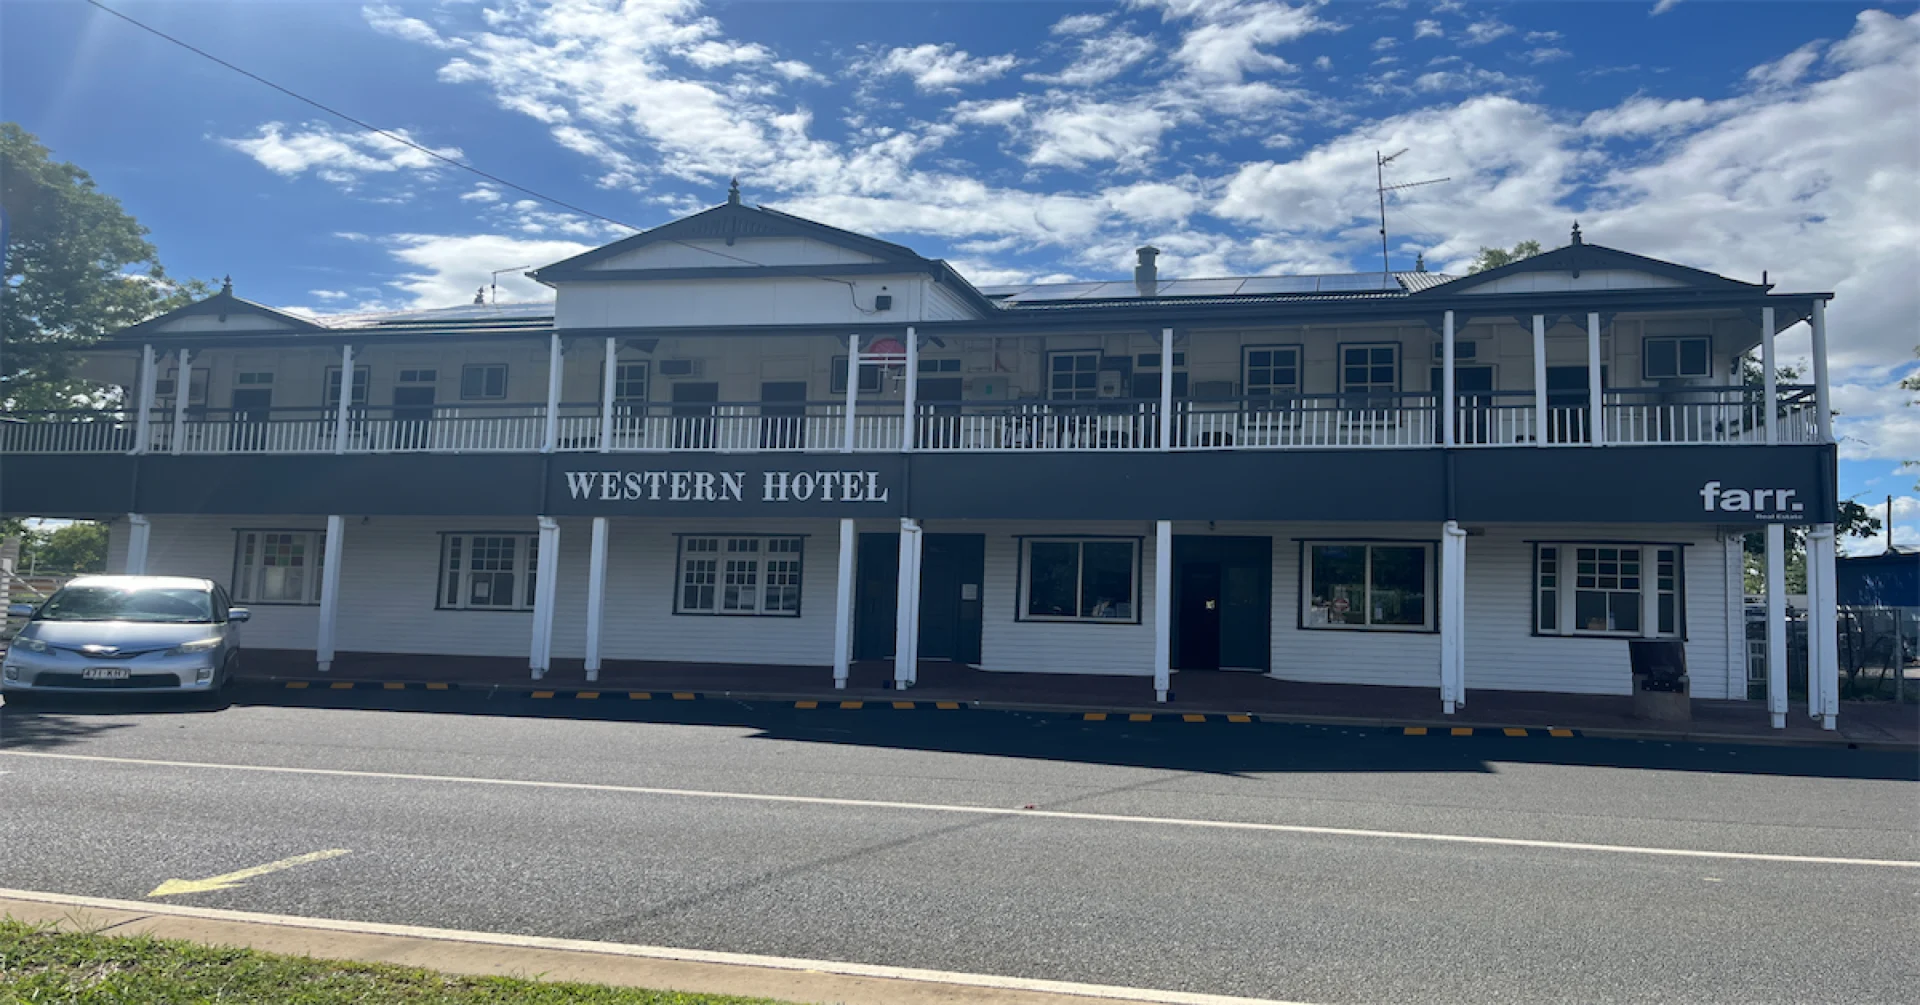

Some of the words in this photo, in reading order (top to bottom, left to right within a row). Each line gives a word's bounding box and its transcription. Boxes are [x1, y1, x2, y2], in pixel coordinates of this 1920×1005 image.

[565, 471, 746, 501] WESTERN
[762, 471, 889, 502] HOTEL
[1699, 480, 1804, 512] farr.
